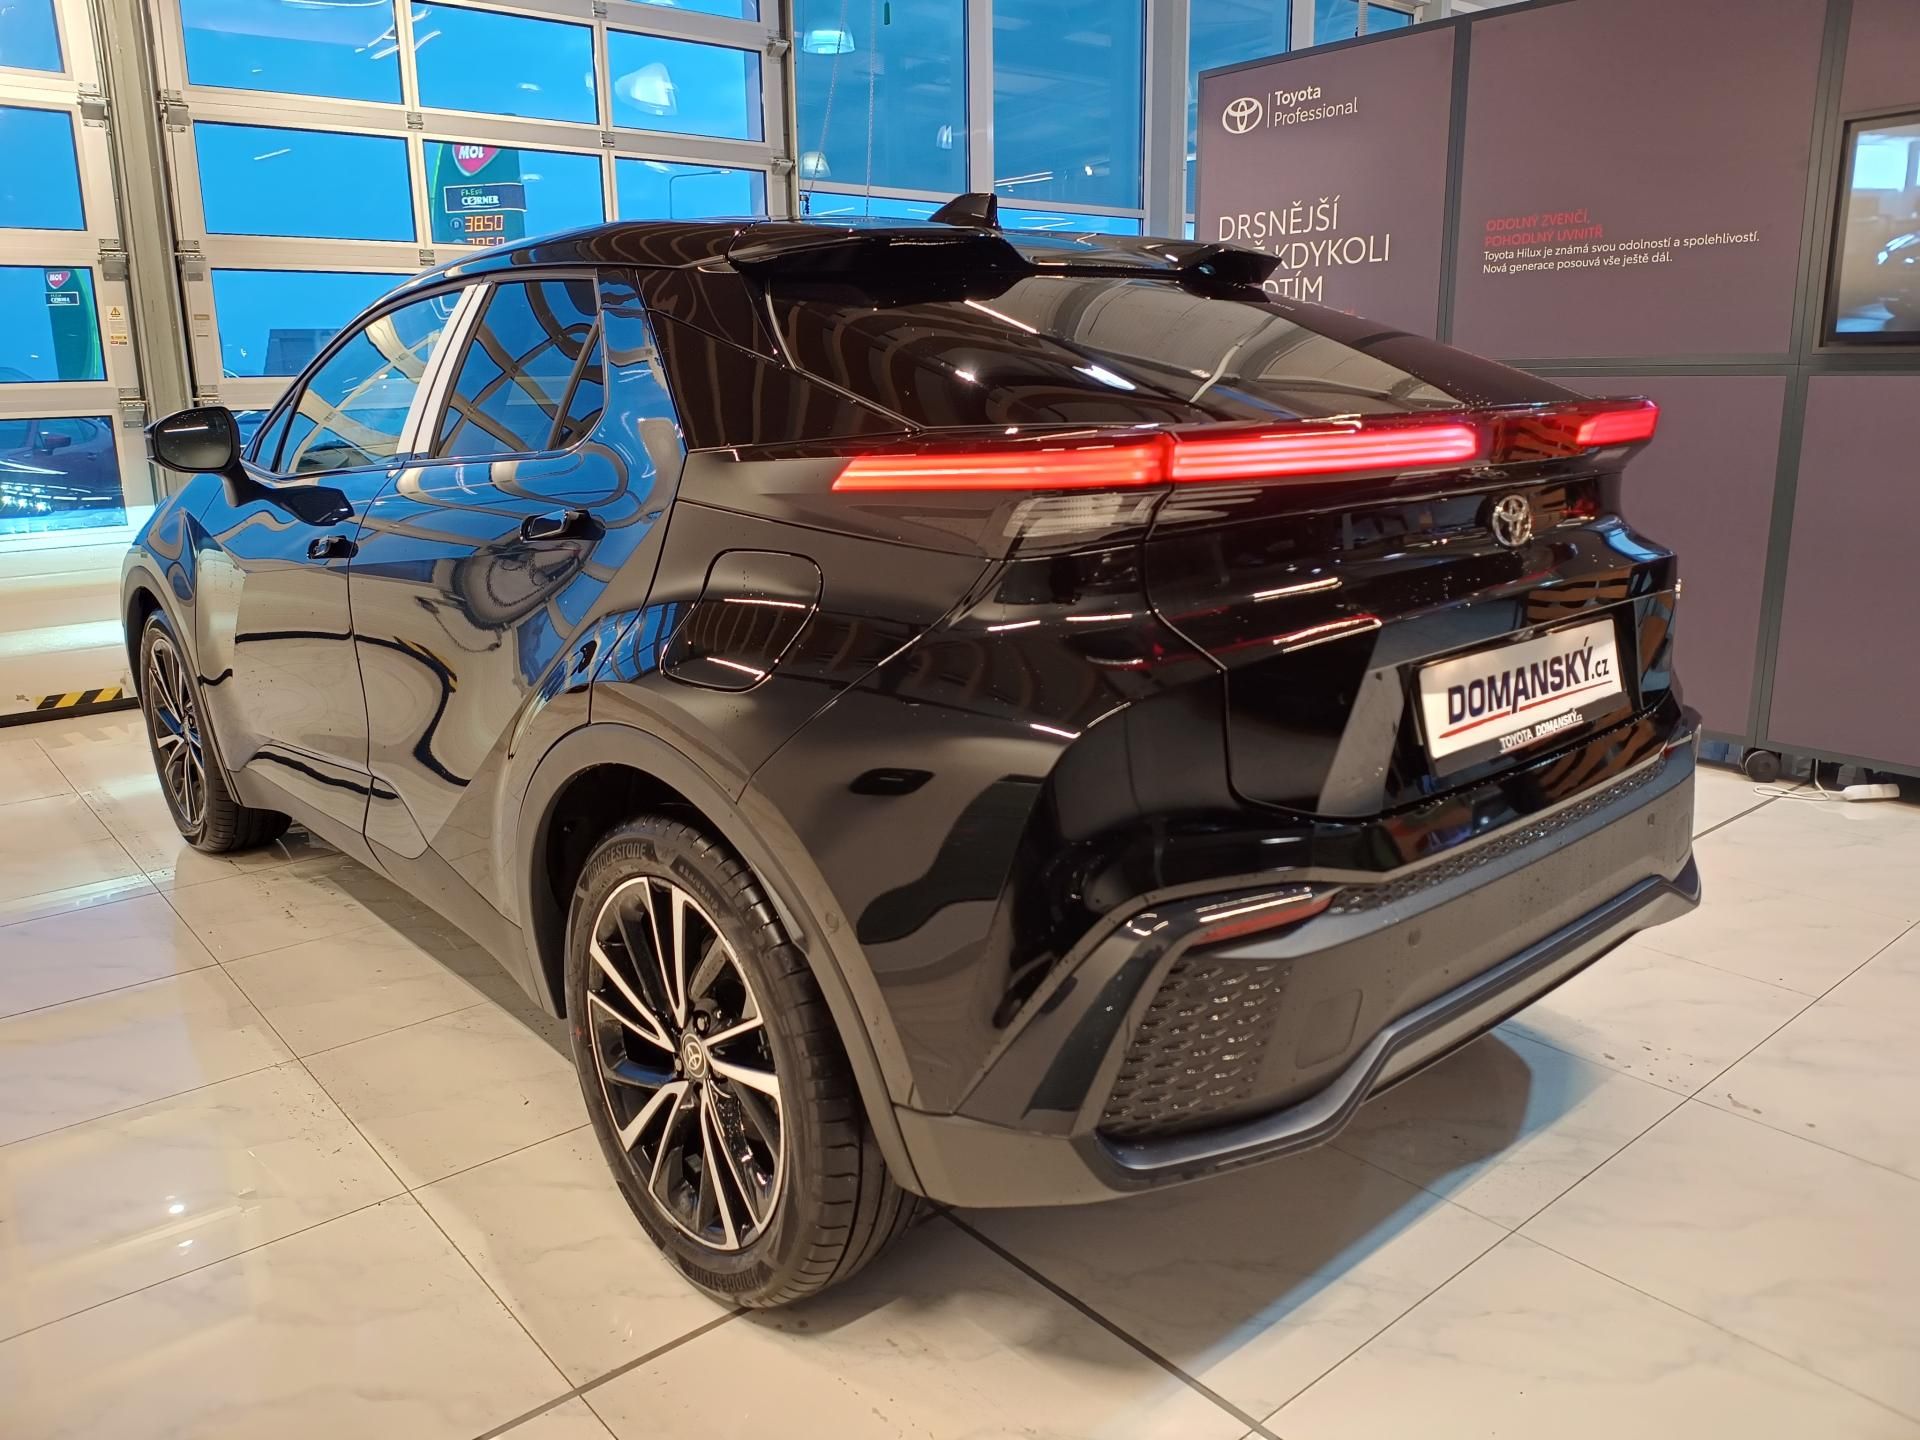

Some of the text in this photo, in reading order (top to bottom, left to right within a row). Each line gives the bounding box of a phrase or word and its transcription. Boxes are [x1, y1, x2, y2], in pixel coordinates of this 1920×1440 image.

[1274, 85, 1321, 108] Toyota
[1274, 96, 1358, 127] Professional
[458, 145, 485, 159] MOL
[1218, 195, 1341, 242] DRSNĚJŠÍ
[1557, 224, 1604, 242] UVNITŘ
[1275, 234, 1391, 271] KDYKOLI
[1483, 231, 1760, 262] Toyota Hilux je známá svou odolností a spolehlivostí.
[1483, 251, 1673, 275] Nová generace posouvá vše ještě dál.
[1499, 728, 1534, 748] TOYOTA
